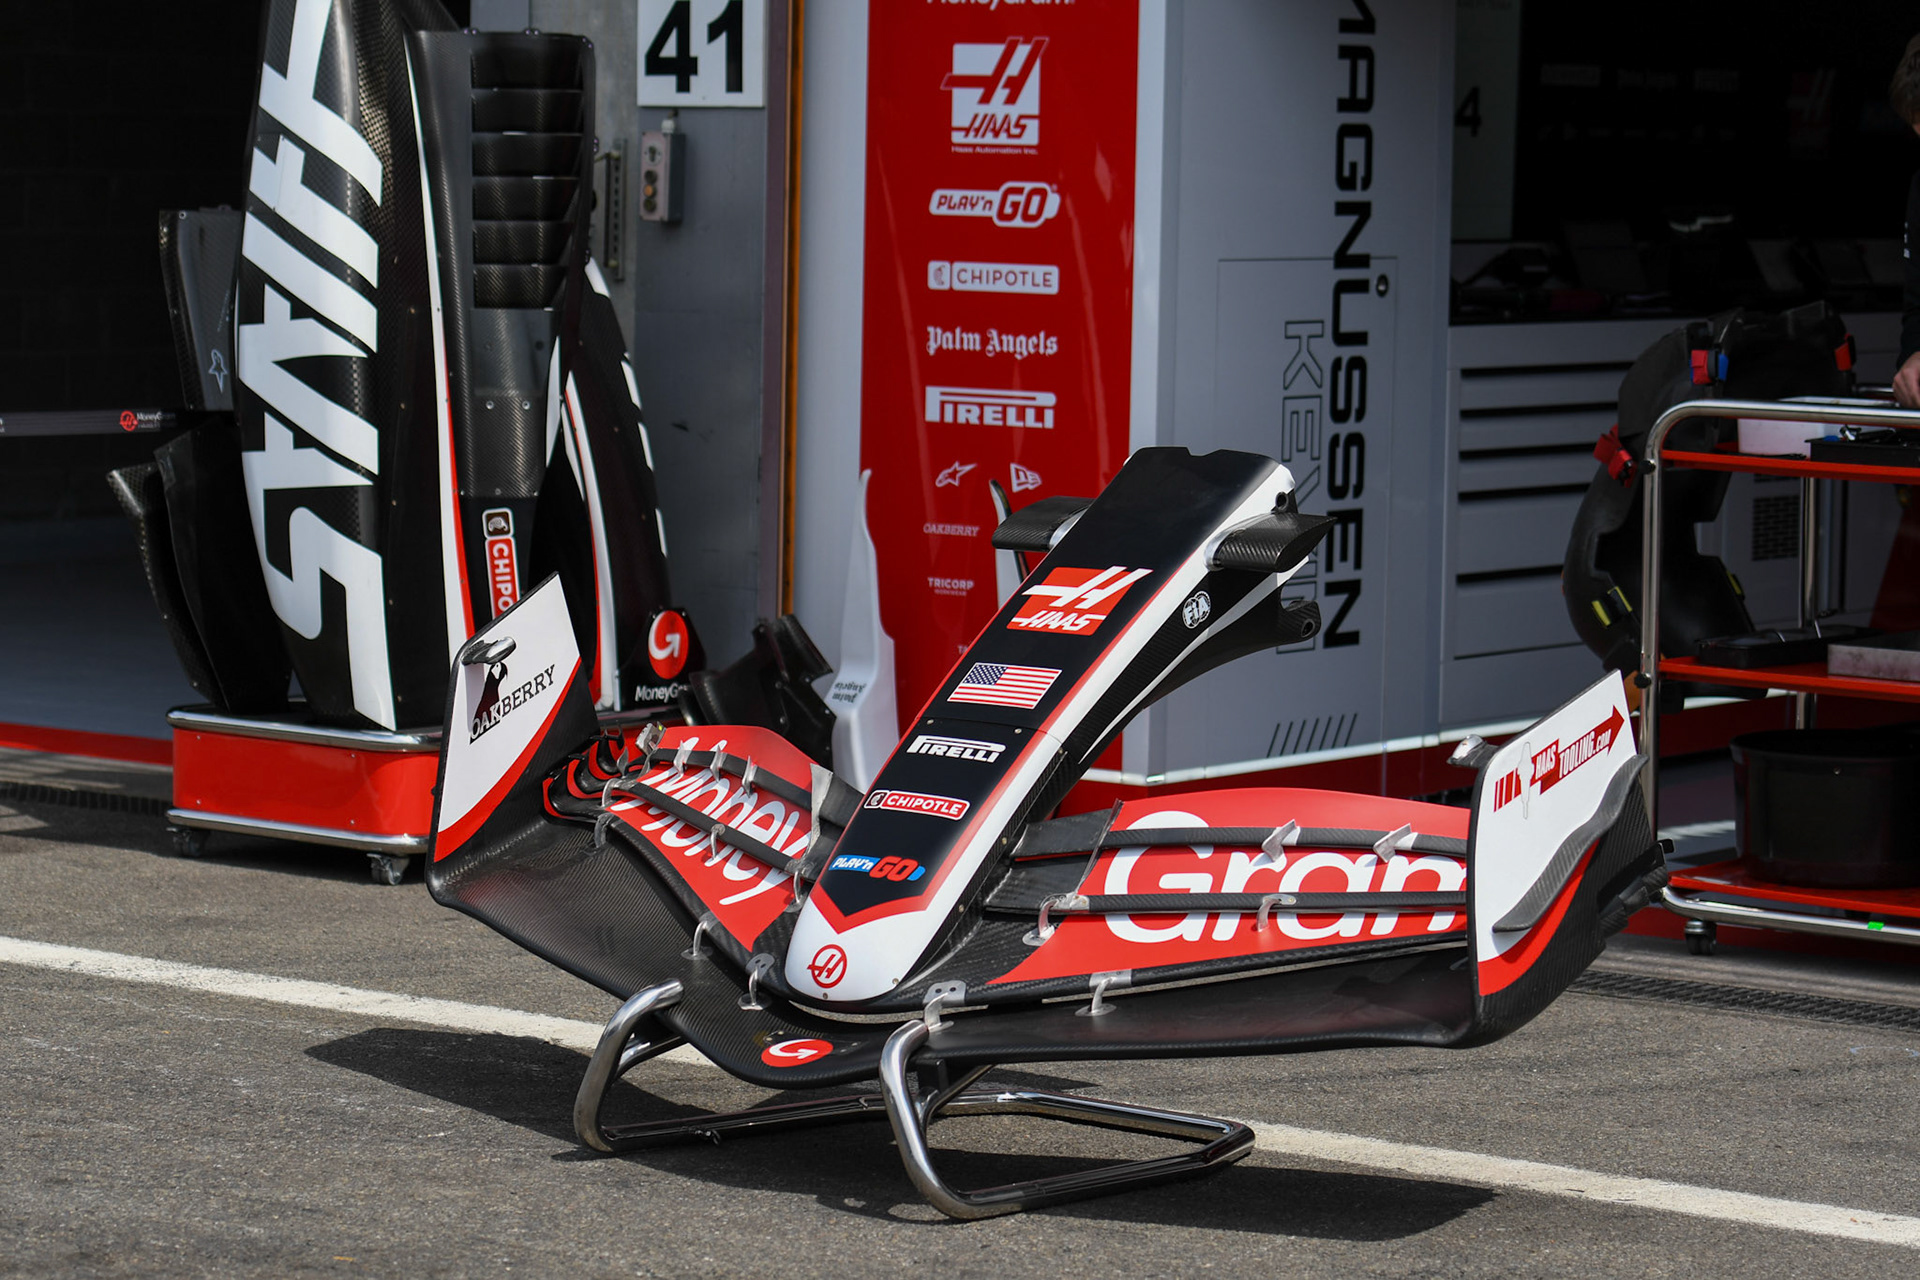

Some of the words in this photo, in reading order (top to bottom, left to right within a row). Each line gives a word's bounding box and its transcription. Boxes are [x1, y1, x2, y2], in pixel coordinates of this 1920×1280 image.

[645, 0, 743, 92] 41
[952, 113, 1039, 138] HAAS
[996, 186, 1048, 223] GO
[957, 268, 1053, 288] CHIPOTLE
[926, 326, 981, 356] Palm
[986, 329, 1058, 360] Angels
[238, 0, 397, 731] HAAS
[925, 386, 1056, 429] PIRELLI
[923, 523, 980, 537] OAKBERRY
[493, 543, 513, 611] CHIPO
[928, 577, 974, 590] TRICORP
[1011, 610, 1107, 631] HAAS
[471, 664, 555, 739] OAKBERRY
[635, 681, 690, 704] MoneyG
[907, 735, 1006, 763] PIRELLI
[1535, 745, 1556, 780] HAAS
[886, 795, 962, 815] CHIPOTLE
[869, 856, 919, 881] GO
